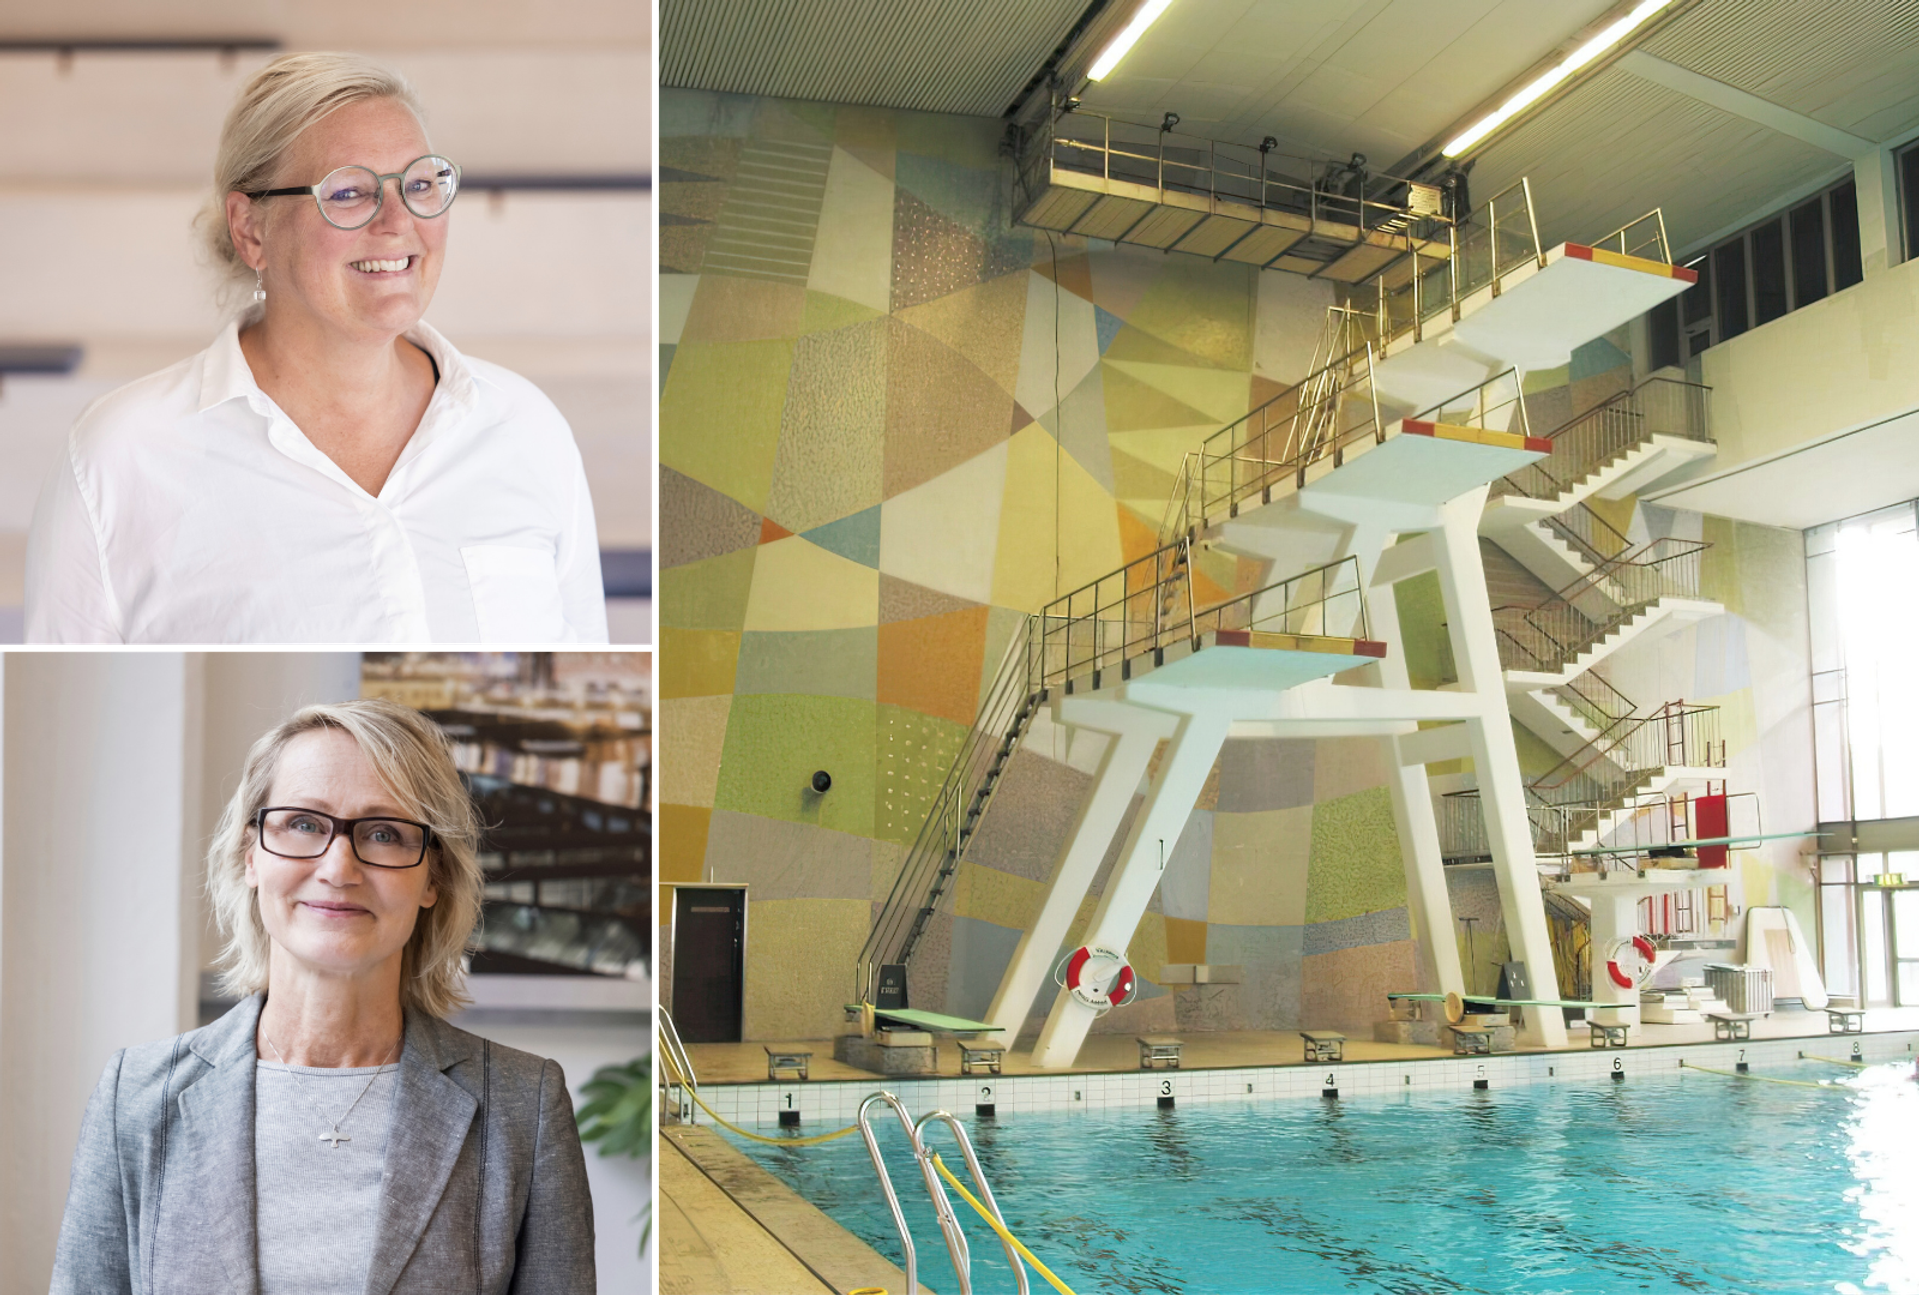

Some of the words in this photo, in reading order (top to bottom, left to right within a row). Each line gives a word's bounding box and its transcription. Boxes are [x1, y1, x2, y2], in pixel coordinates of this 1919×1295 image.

[1852, 1040, 1861, 1054] 8
[1738, 1048, 1746, 1062] 7
[1477, 1064, 1486, 1078] 5
[1613, 1056, 1623, 1071] 6
[1160, 1080, 1172, 1096] 3
[1325, 1073, 1335, 1088] 4
[785, 1092, 793, 1109] 1
[981, 1086, 992, 1103] 2
